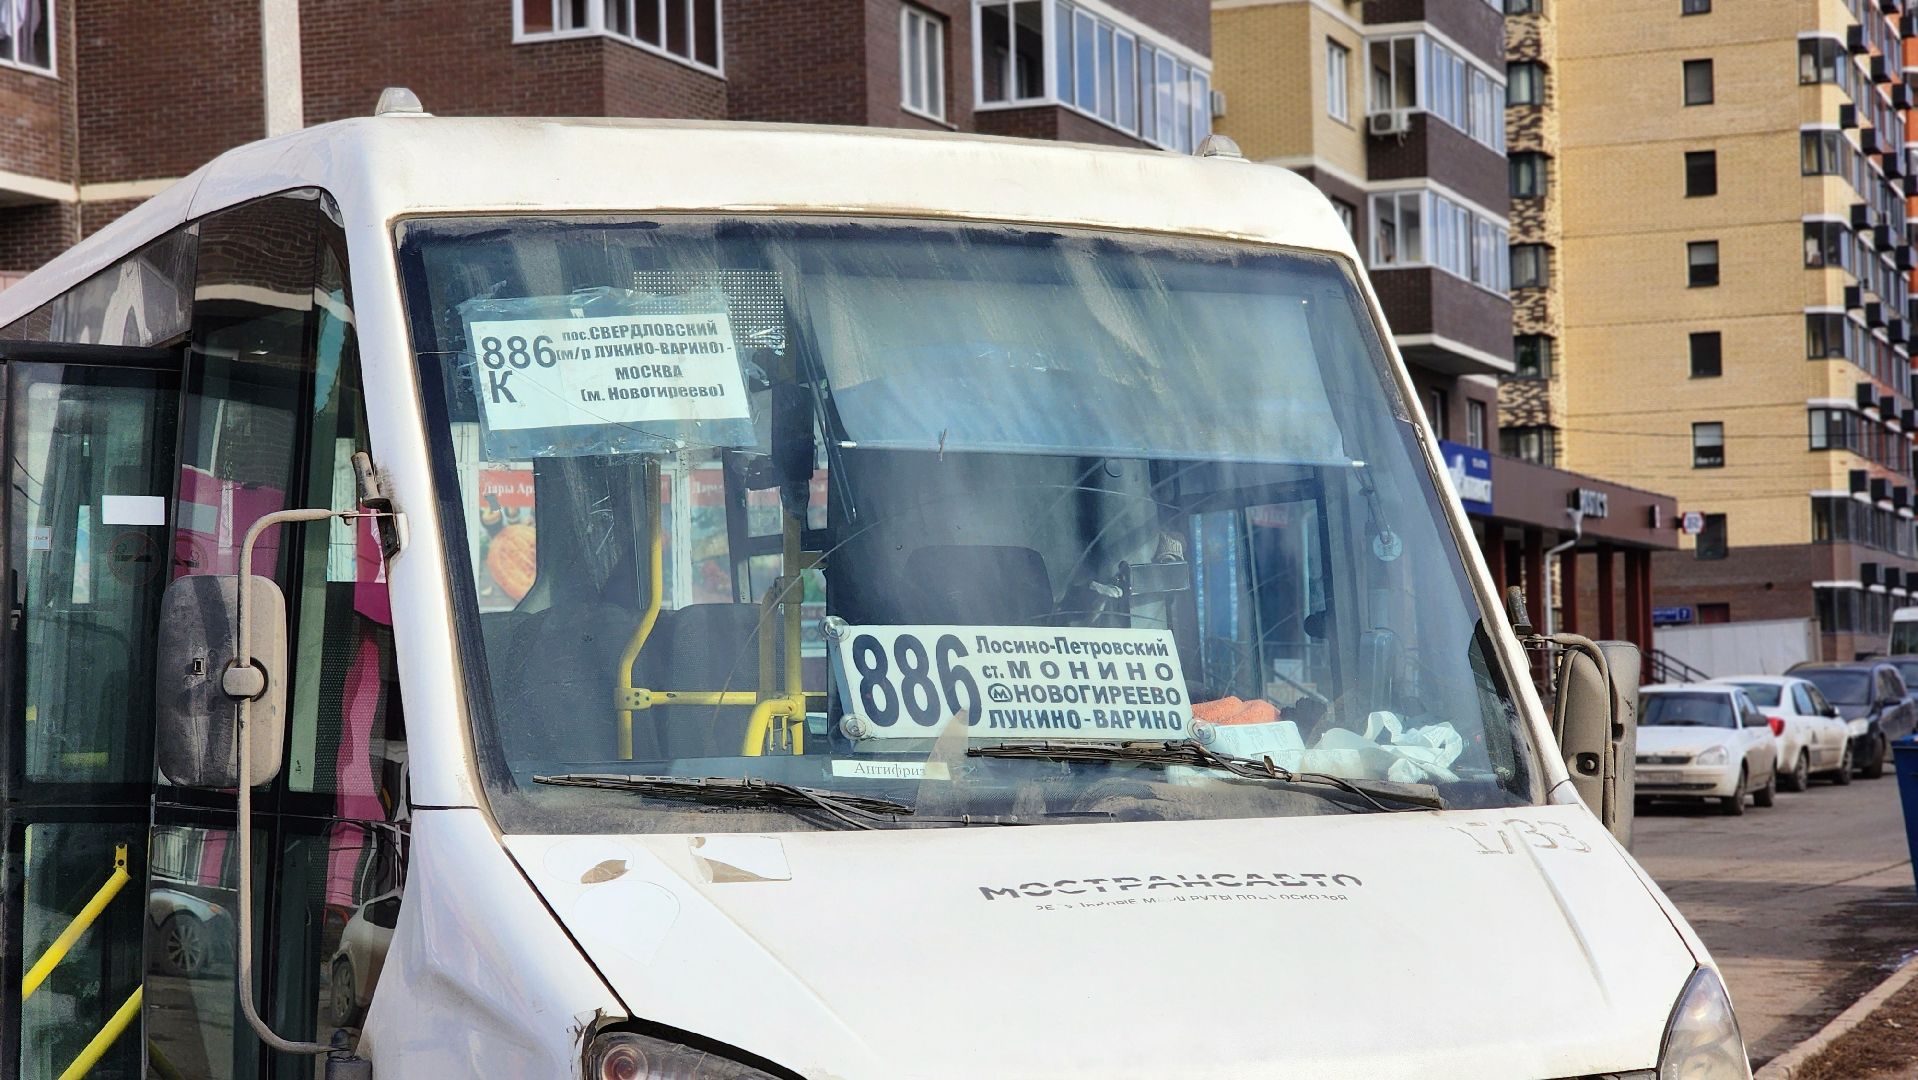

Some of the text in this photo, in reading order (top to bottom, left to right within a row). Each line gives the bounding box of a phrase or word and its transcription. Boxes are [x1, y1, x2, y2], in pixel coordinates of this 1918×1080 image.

[481, 335, 557, 370] 886
[615, 364, 683, 381] МОСКВА
[489, 370, 517, 404] К
[976, 636, 1169, 659] Лосино-Петровский
[852, 634, 982, 727] 886
[1007, 661, 1174, 681] МОНИНО
[1013, 684, 1181, 705] НОВОГИРЕЕВО
